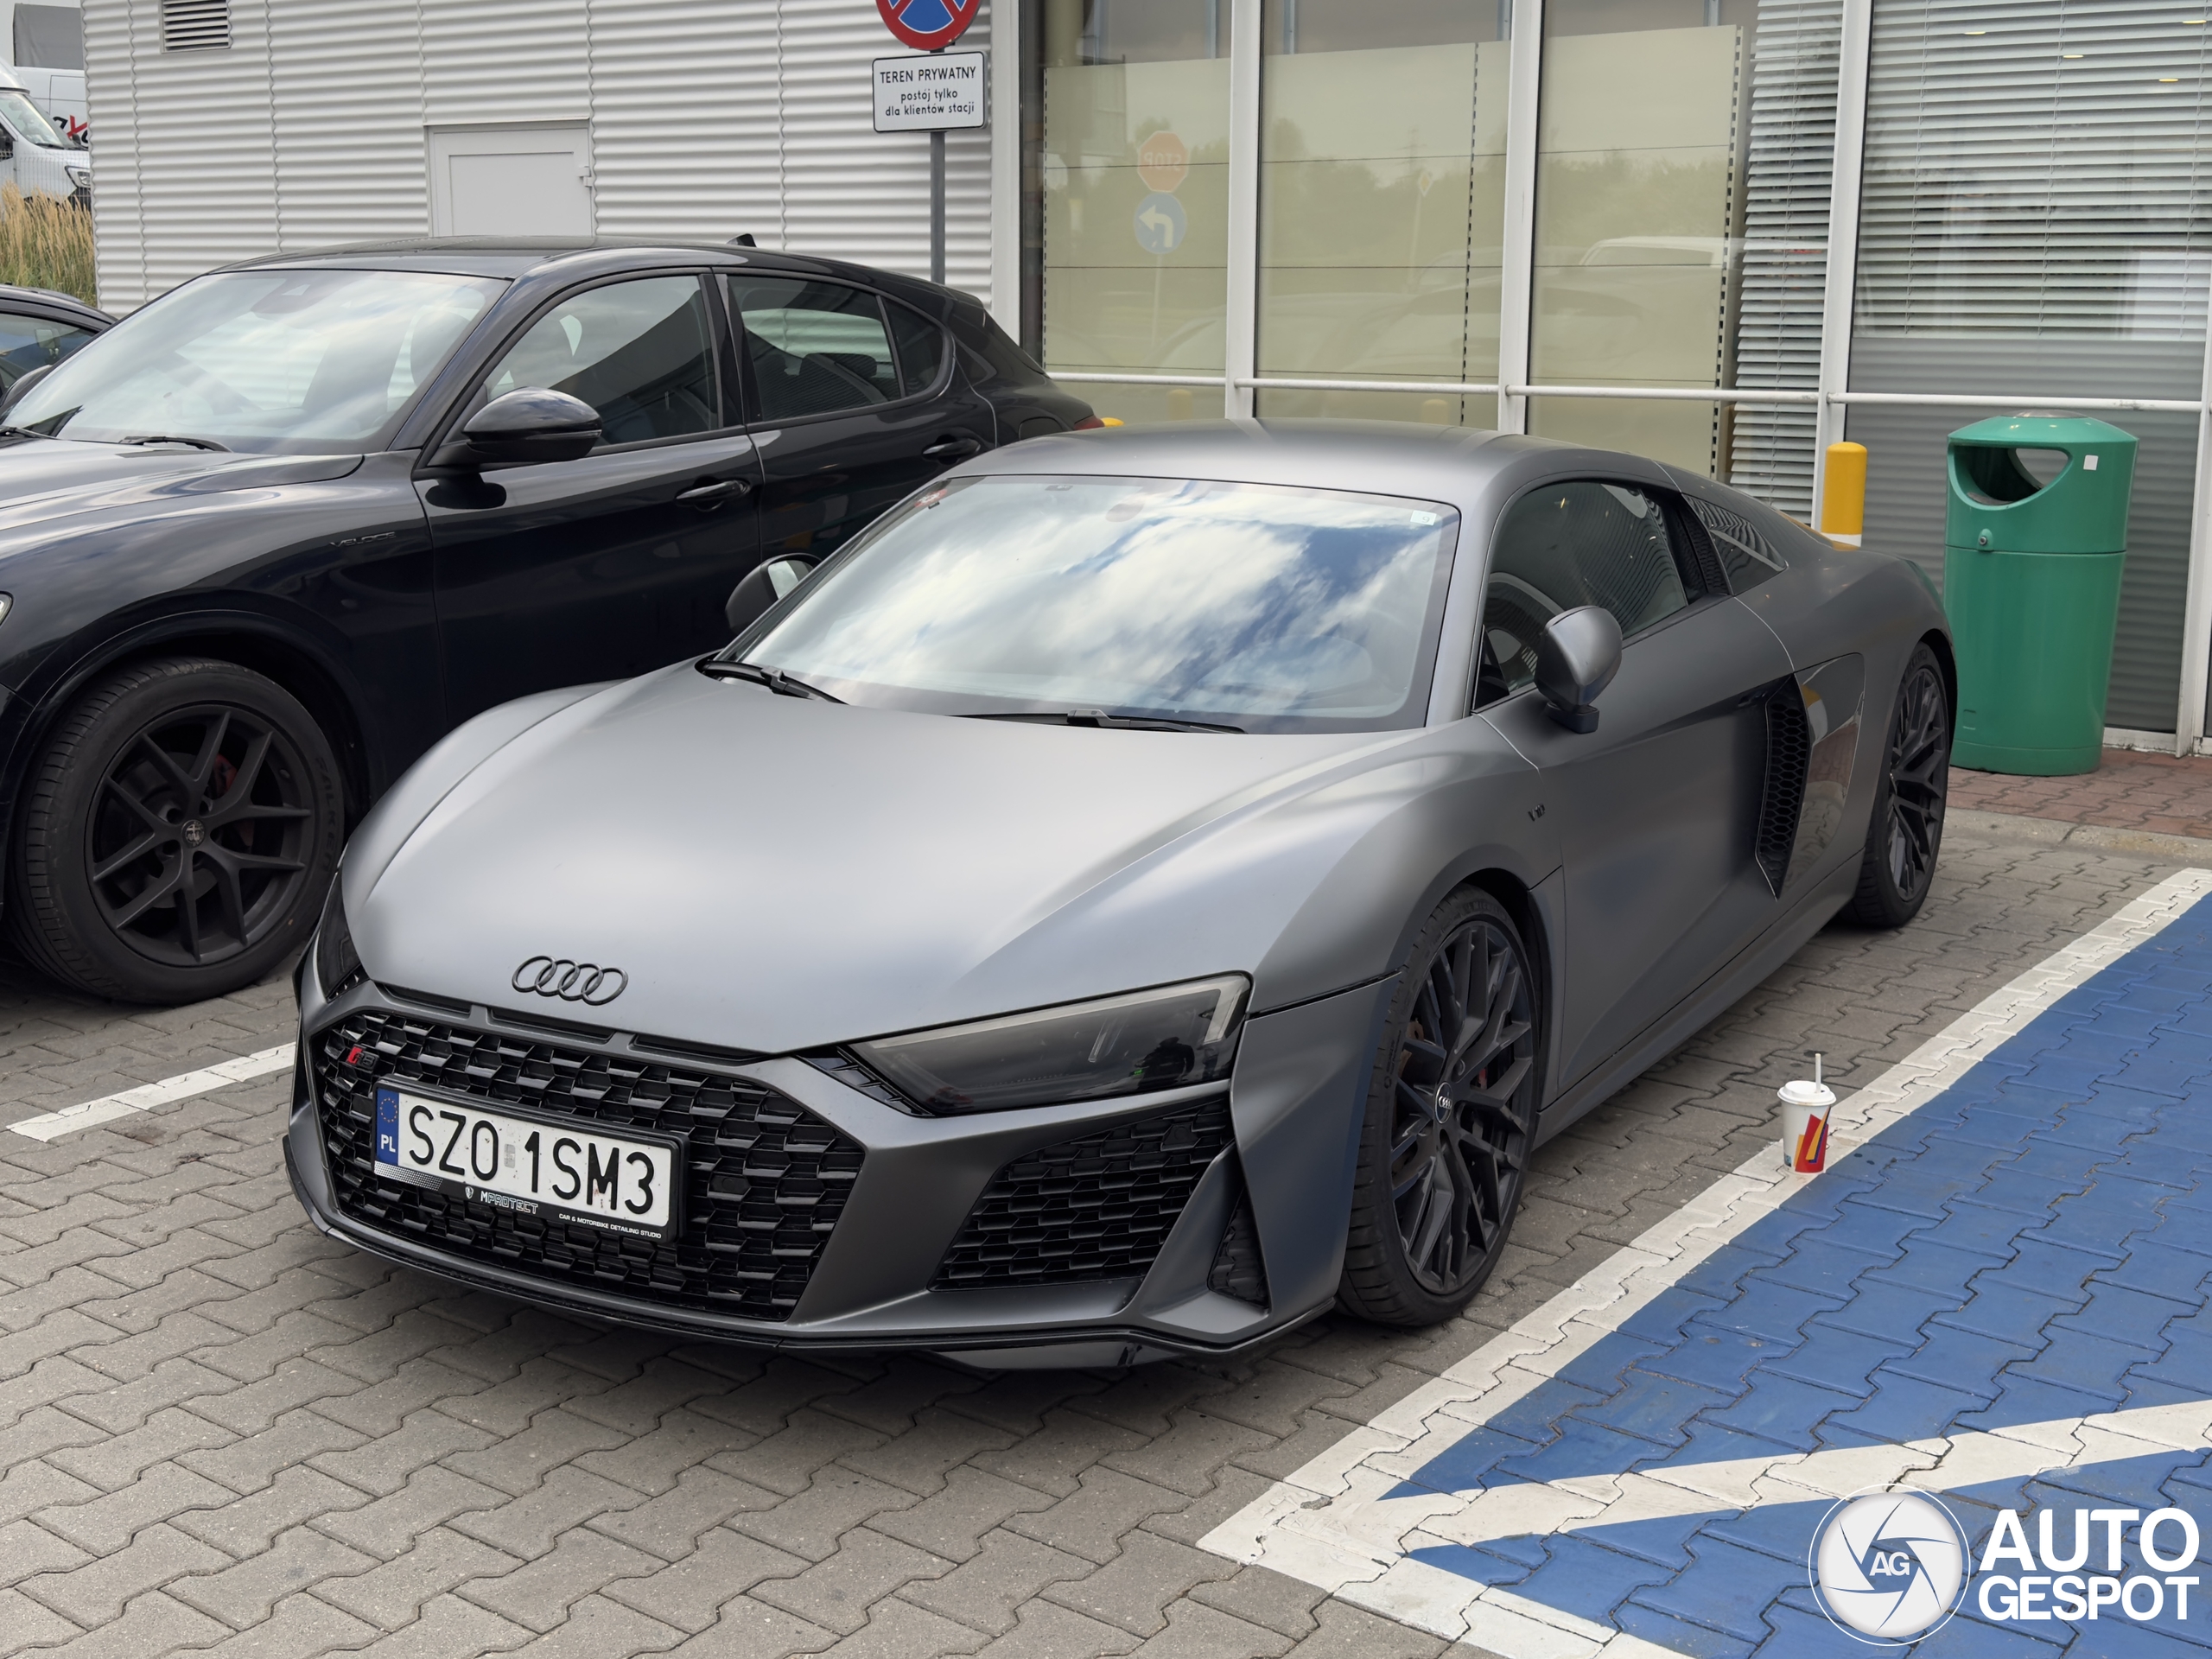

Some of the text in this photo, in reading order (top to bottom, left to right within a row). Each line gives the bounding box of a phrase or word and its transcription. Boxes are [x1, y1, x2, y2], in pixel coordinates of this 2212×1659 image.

[880, 67, 976, 84] TEREN PRYWATNY
[900, 87, 958, 104] postój tylko
[885, 101, 975, 117] dla klientów stacji
[329, 531, 397, 548] VELOCE
[380, 1134, 397, 1154] PL
[524, 1130, 655, 1215] 1SM3
[480, 1190, 539, 1215] MPROTECT
[558, 1212, 570, 1221] CAR
[577, 1217, 609, 1230] MOTORBIKE
[610, 1224, 639, 1235] DETAILING
[640, 1229, 662, 1239] STUDIO
